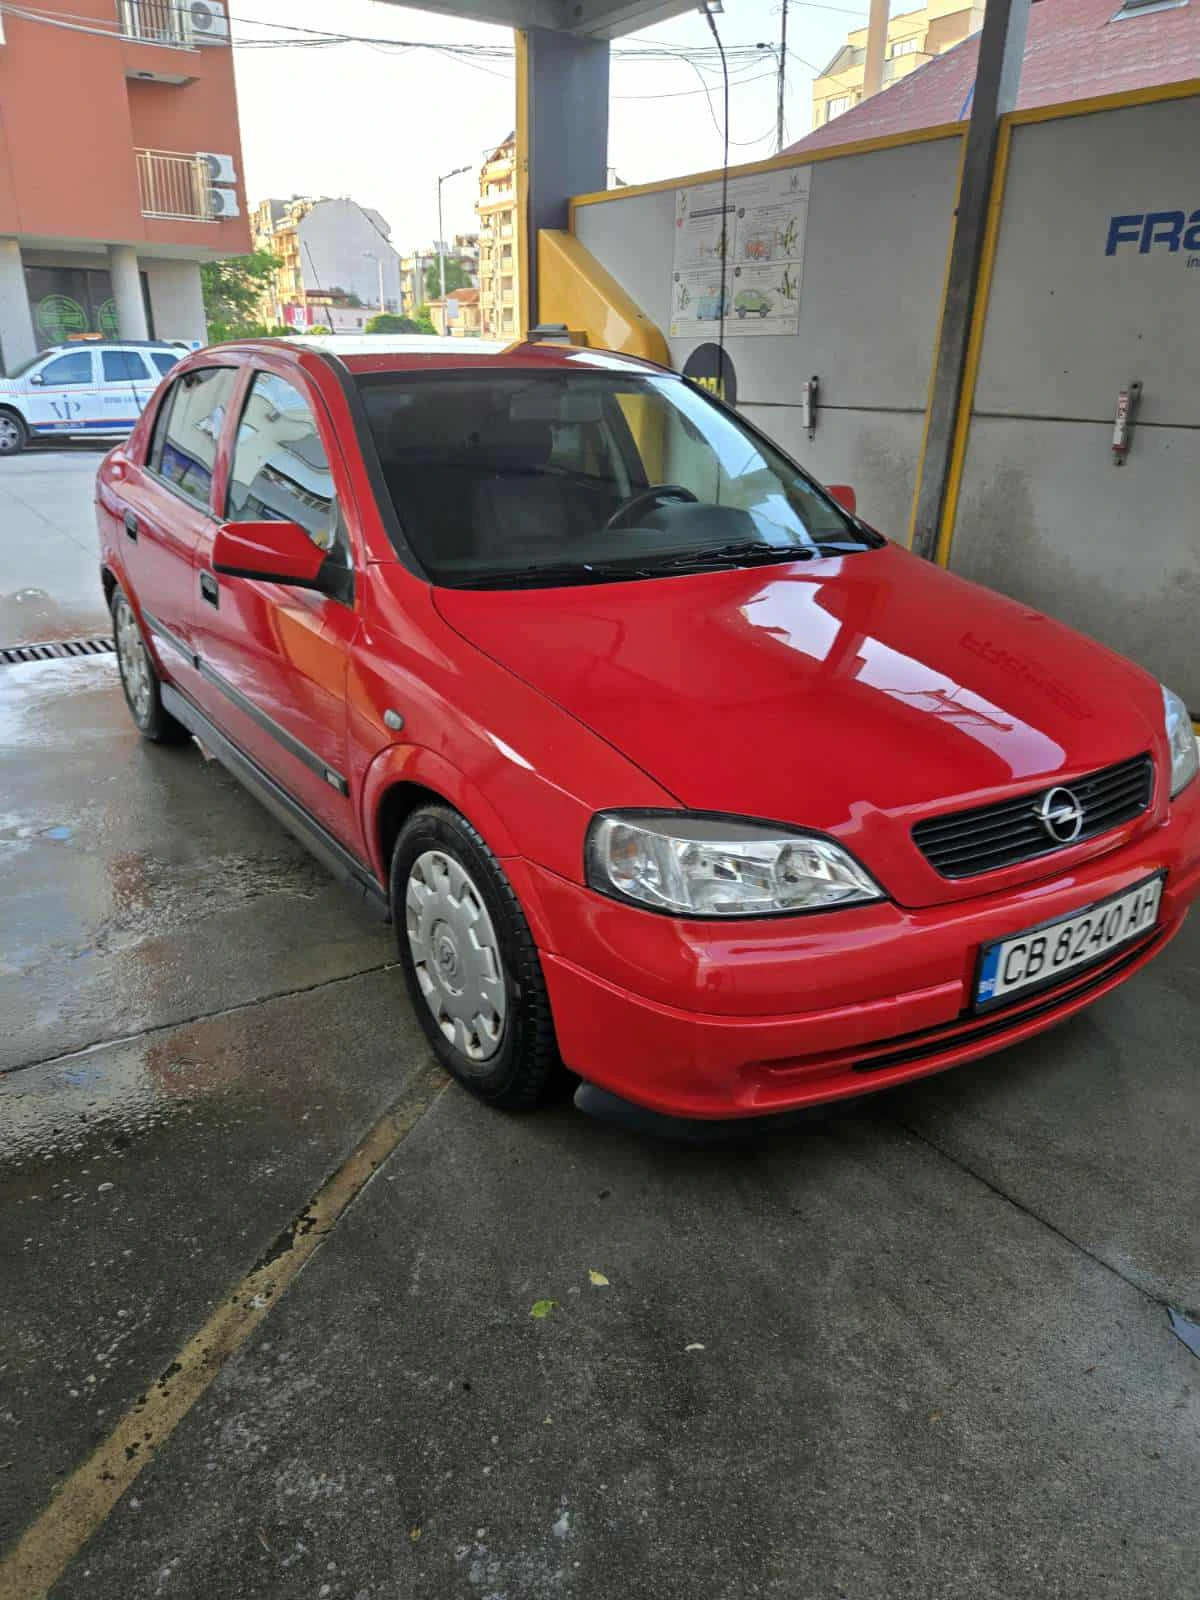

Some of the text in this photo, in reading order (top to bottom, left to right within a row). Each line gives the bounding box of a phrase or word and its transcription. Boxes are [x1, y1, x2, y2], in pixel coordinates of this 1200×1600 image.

[1003, 879, 1163, 985] CB 8240 AH
